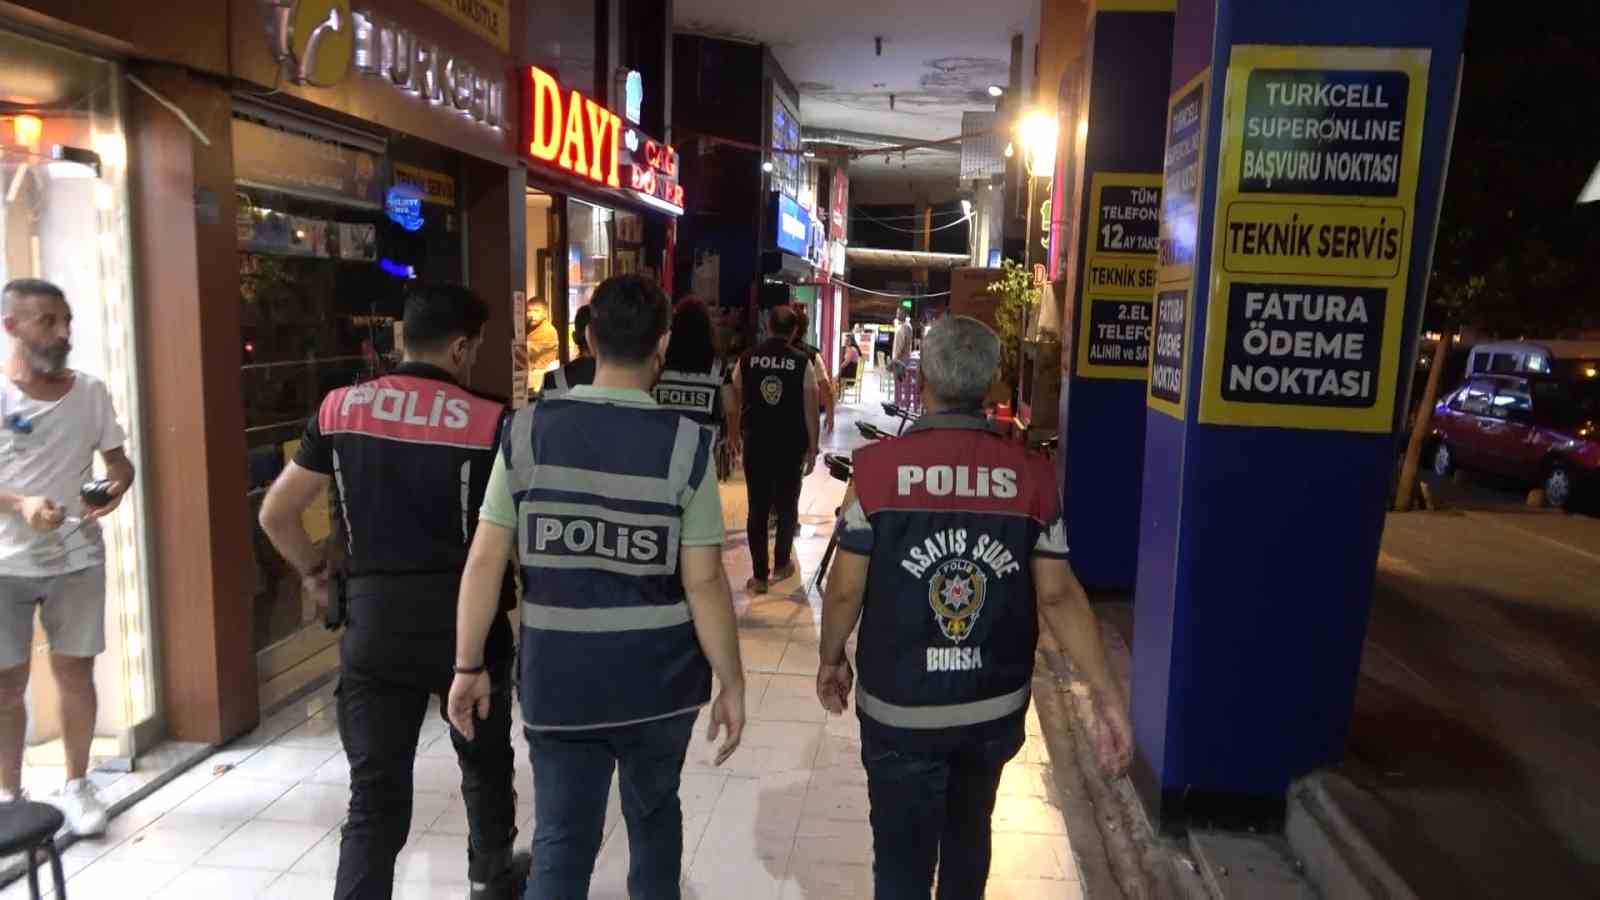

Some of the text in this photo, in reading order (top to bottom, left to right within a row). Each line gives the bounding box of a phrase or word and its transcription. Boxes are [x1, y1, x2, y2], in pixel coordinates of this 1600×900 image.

[1264, 82, 1390, 109] TURKCELL
[531, 66, 621, 188] DAYI
[1248, 116, 1401, 142] SUPERONLINE
[1243, 149, 1321, 188] BAŞVURU
[1324, 151, 1399, 184] NOKTASI
[1131, 187, 1158, 205] TÜM
[1101, 223, 1124, 249] 12
[1230, 213, 1313, 257] TEKNİK
[1318, 216, 1399, 260] SERVİS
[1118, 304, 1149, 321] 2.EL
[1245, 292, 1368, 323] FATURA
[1135, 346, 1151, 362] SA
[1243, 321, 1365, 360] ÖDEME
[1229, 364, 1372, 398] NOKTASI
[972, 533, 1021, 580] ŞUBE
[927, 646, 983, 673] BURSA
